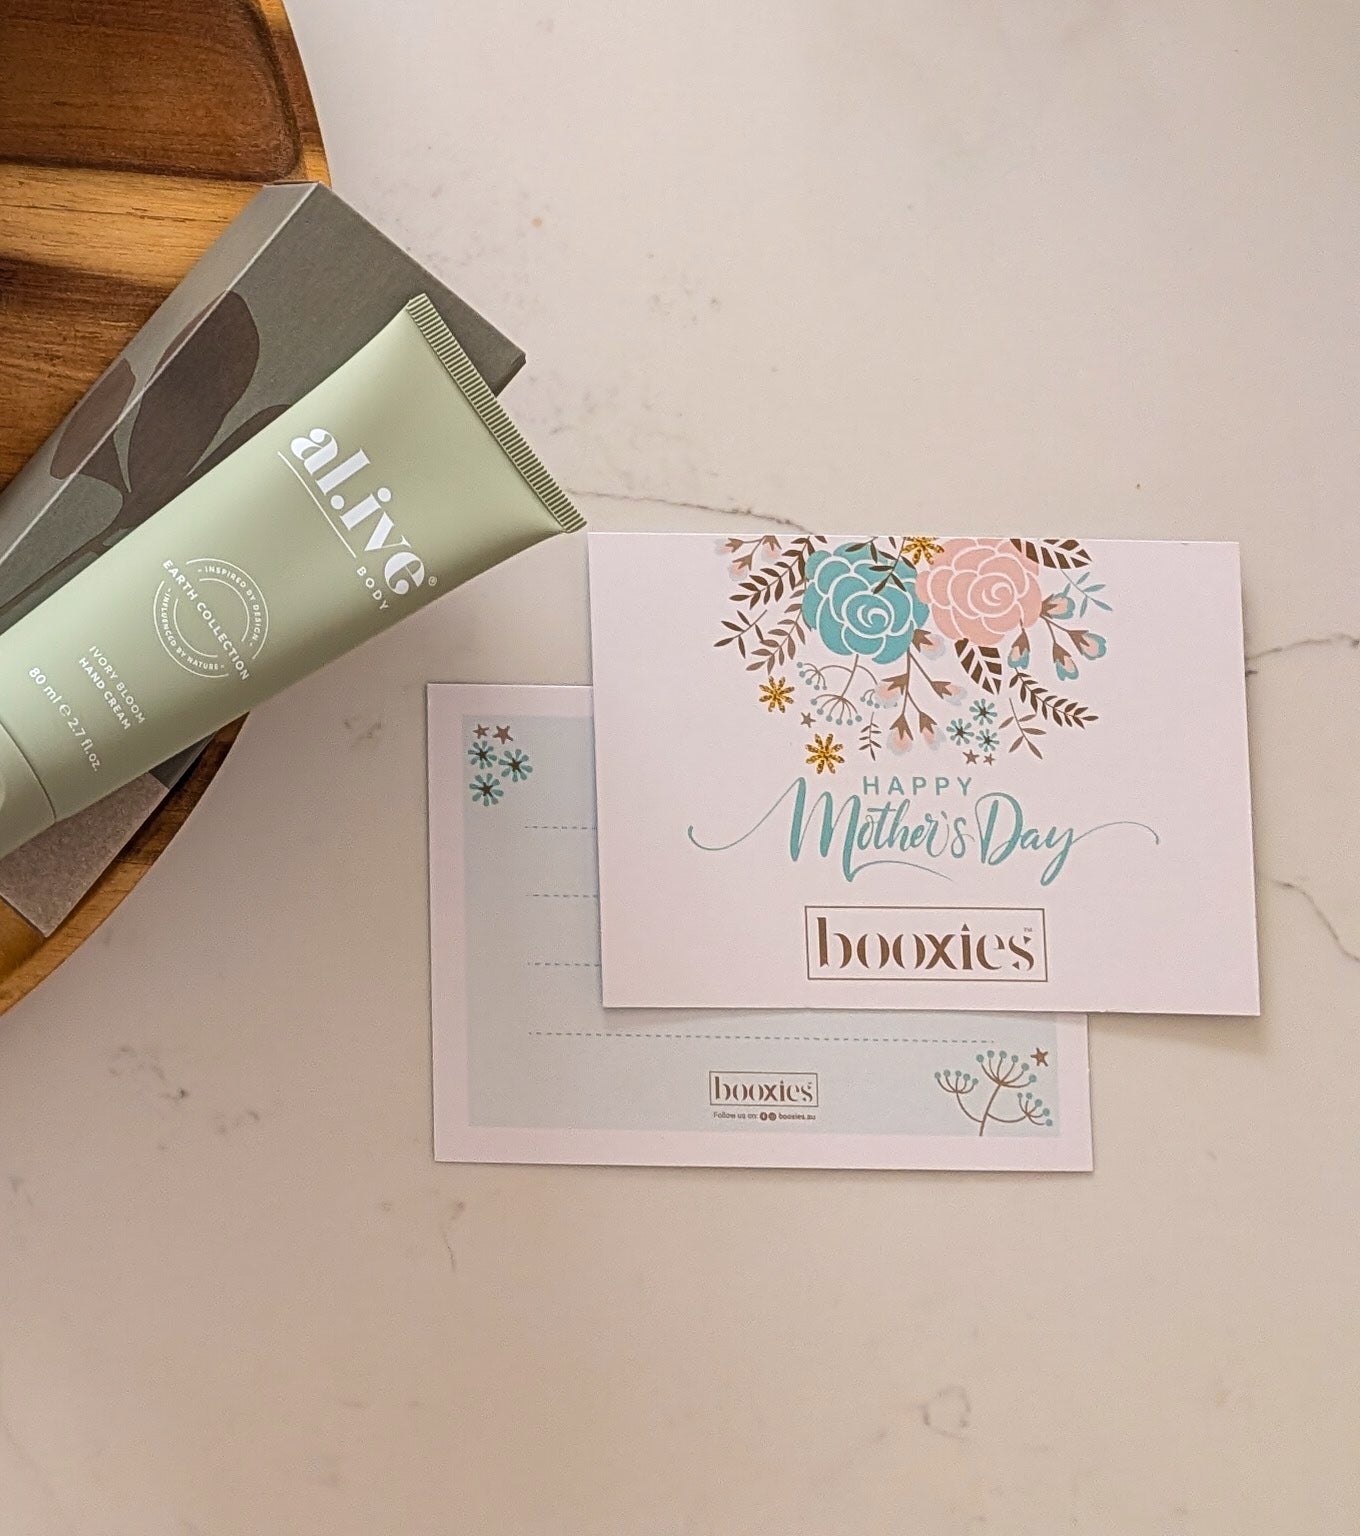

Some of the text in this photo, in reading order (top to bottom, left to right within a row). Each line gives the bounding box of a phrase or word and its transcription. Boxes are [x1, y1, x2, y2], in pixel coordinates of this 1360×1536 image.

[290, 428, 426, 596] al.ive
[163, 559, 250, 681] EARTH COLLECTION
[204, 565, 262, 641] INSPIRED BY DESIGN
[356, 566, 390, 610] BODY
[78, 657, 132, 730] HAND CREAM
[89, 645, 146, 724] IVORY BLOOM
[176, 646, 186, 657] BY
[187, 656, 219, 671] NATURE
[28, 667, 47, 685] 80
[43, 685, 62, 704] ml
[67, 717, 86, 737] 2.7
[862, 775, 974, 797] HAPPY
[720, 776, 1118, 886] Mother's Day
[817, 916, 1036, 973] booxies
[713, 1111, 736, 1119] Follow
[714, 1076, 813, 1102] booxies
